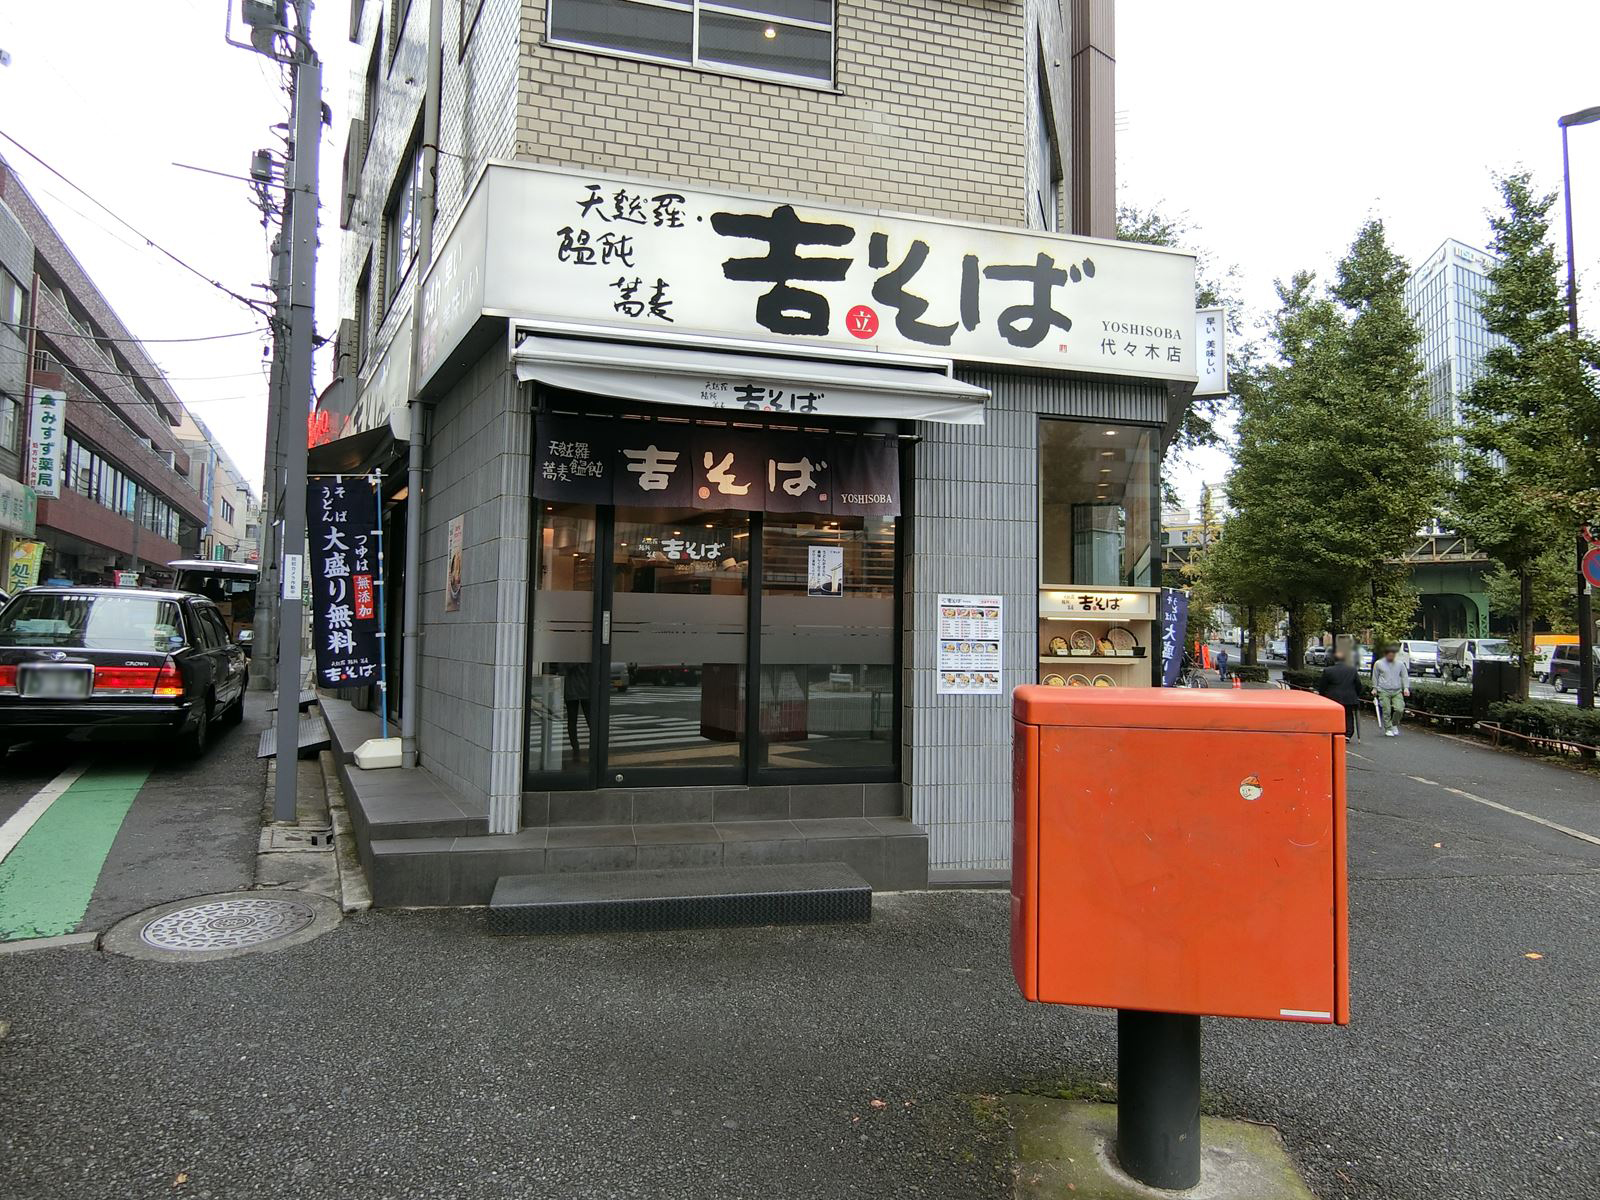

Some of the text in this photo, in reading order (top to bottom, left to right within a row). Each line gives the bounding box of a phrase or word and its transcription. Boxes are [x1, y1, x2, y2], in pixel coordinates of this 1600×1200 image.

[1101, 320, 1182, 340] YOSHISOBA
[1205, 317, 1216, 375] 早い 美味しい
[1101, 338, 1182, 363] 代々木店
[37, 410, 57, 487] みすず薬局
[322, 486, 334, 522] うどん
[334, 486, 348, 522] そば
[841, 493, 893, 505] YOSHISOBA
[322, 526, 357, 655] 大盛り無料
[354, 535, 373, 617] つゆは 無添加
